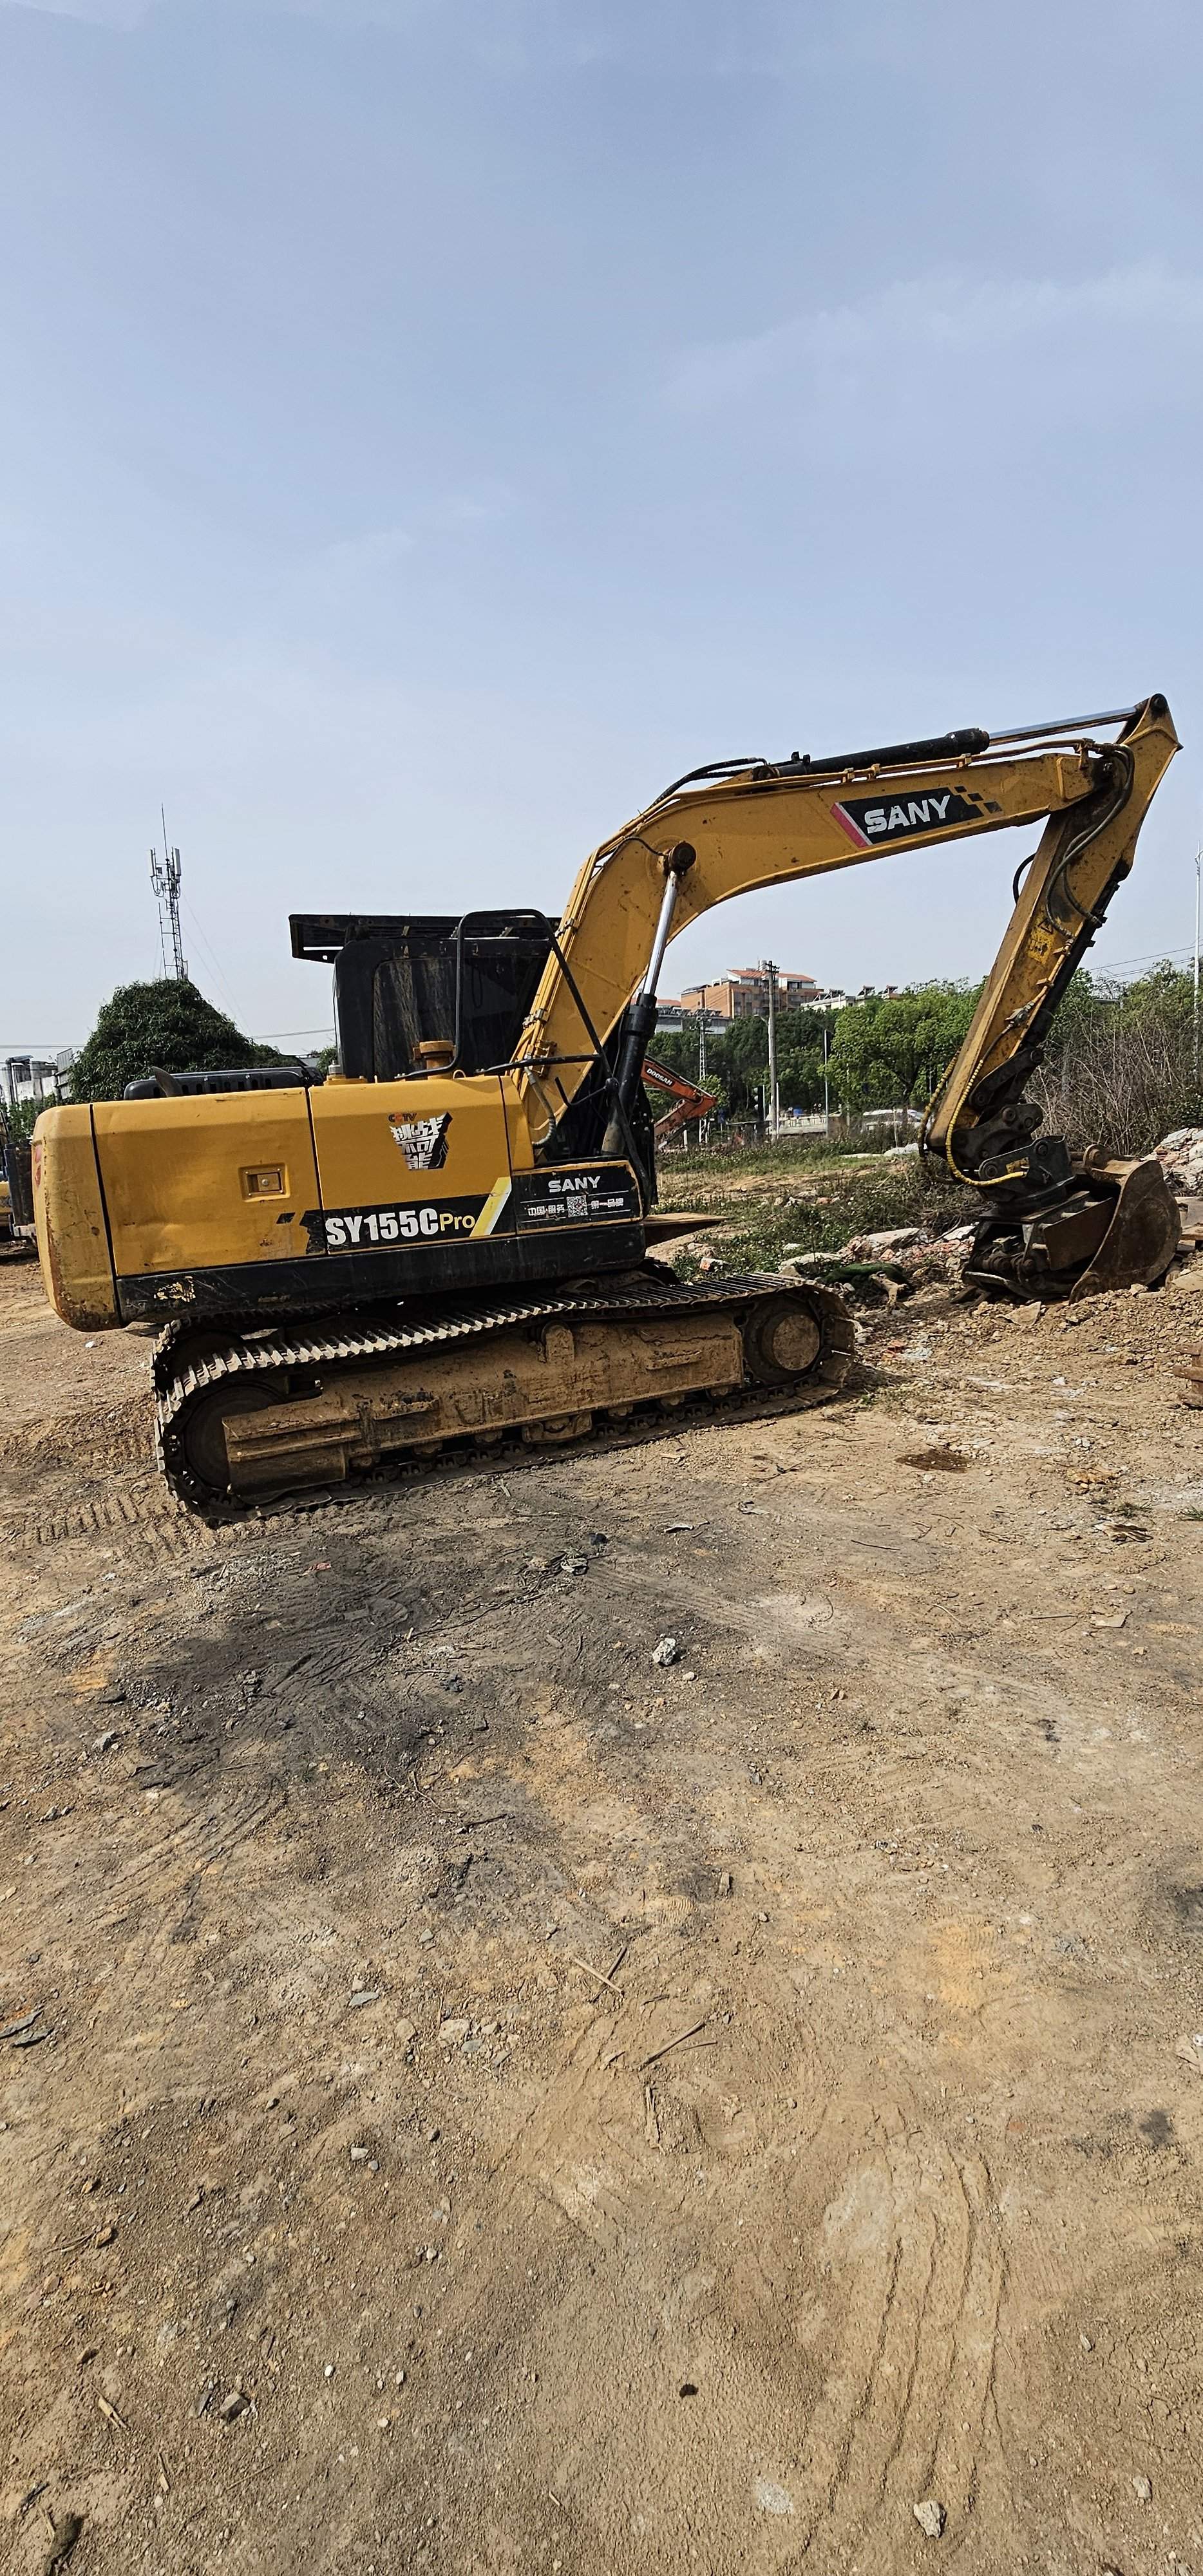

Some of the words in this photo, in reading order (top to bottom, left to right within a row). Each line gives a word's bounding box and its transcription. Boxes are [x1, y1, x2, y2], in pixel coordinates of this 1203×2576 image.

[864, 795, 951, 834] SANY
[647, 1068, 672, 1085] DOOSAN
[548, 1176, 601, 1193] SANY
